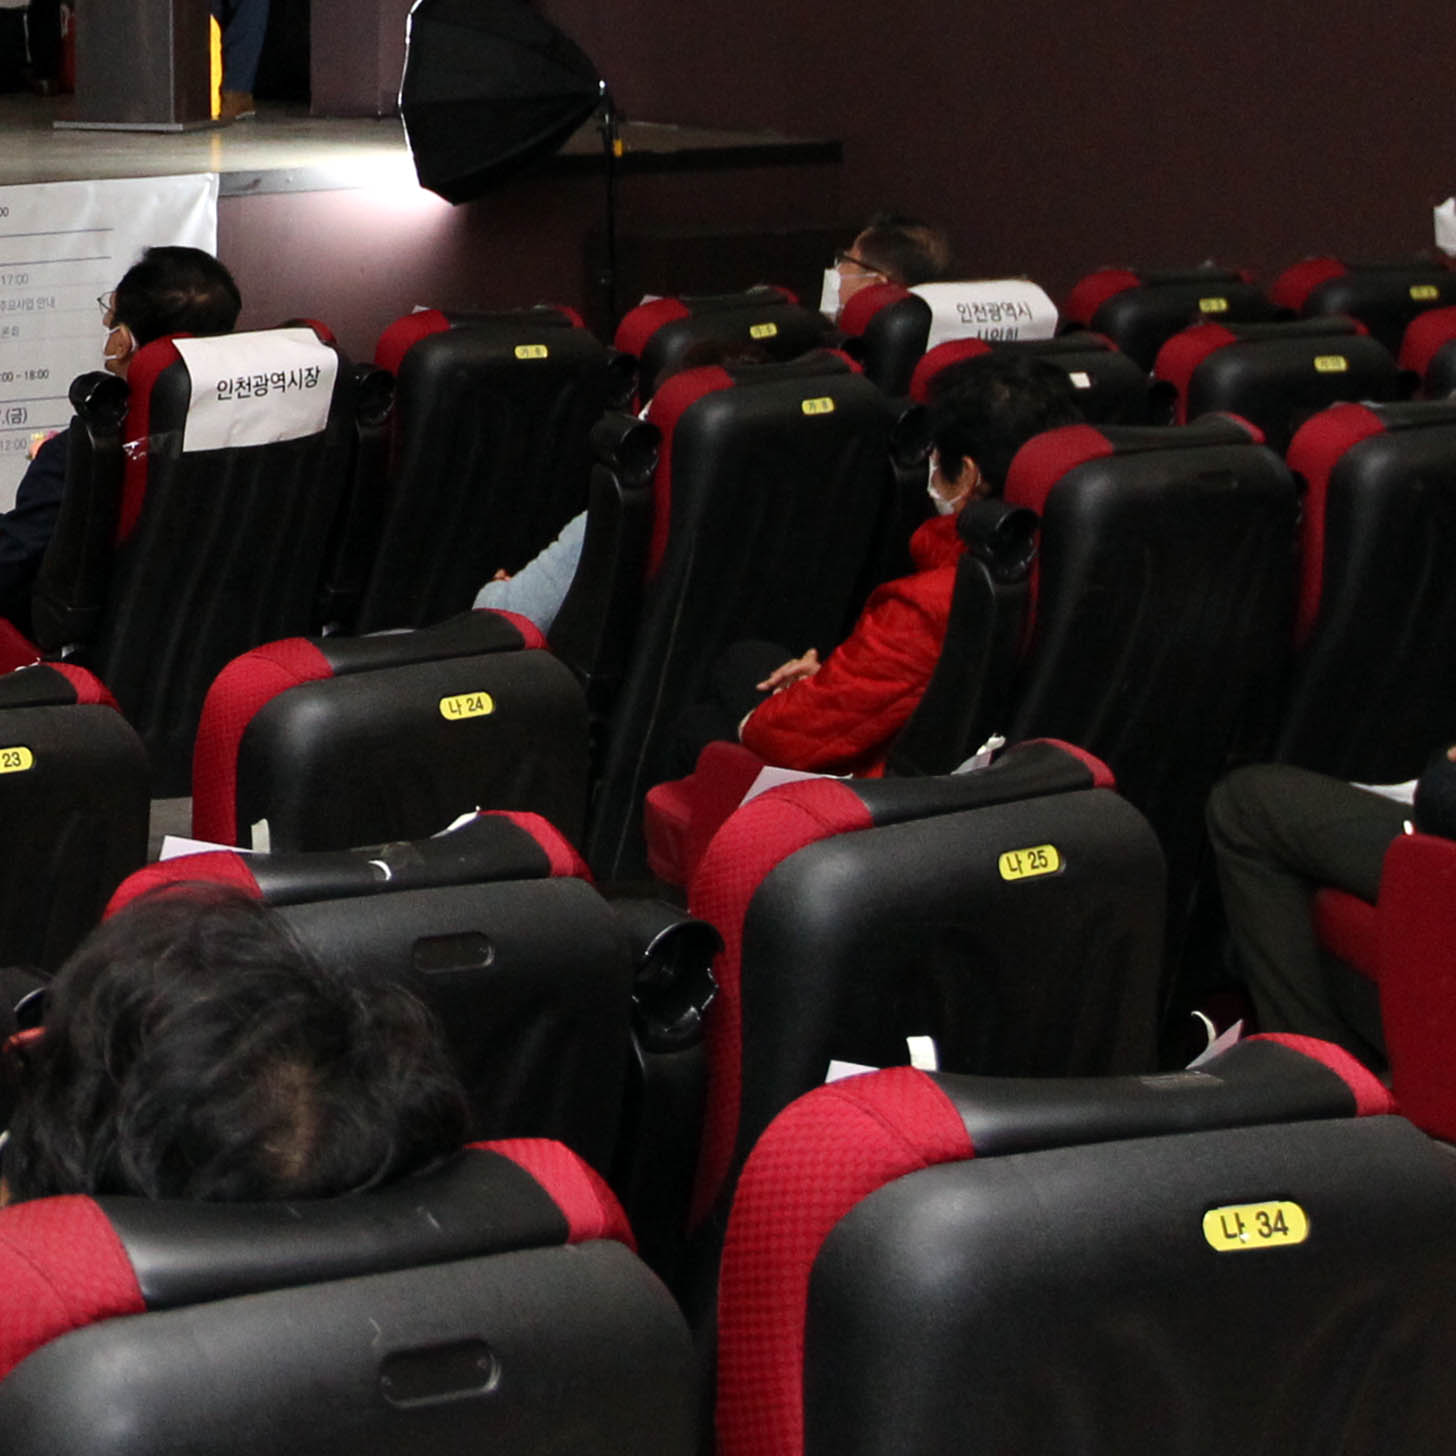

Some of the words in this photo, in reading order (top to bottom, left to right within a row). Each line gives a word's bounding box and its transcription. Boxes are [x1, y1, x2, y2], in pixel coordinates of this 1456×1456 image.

[0, 272, 29, 285] 17:00
[956, 301, 1033, 324] 인천광역시
[24, 369, 50, 381] 18:00
[215, 365, 321, 402] 인천광역시장
[448, 700, 462, 715] 나
[468, 696, 484, 711] 24
[2, 752, 21, 767] 23
[1006, 855, 1024, 874] 나
[1028, 850, 1049, 869] 25
[1220, 1213, 1248, 1243] 나
[1257, 1211, 1288, 1237] 34
